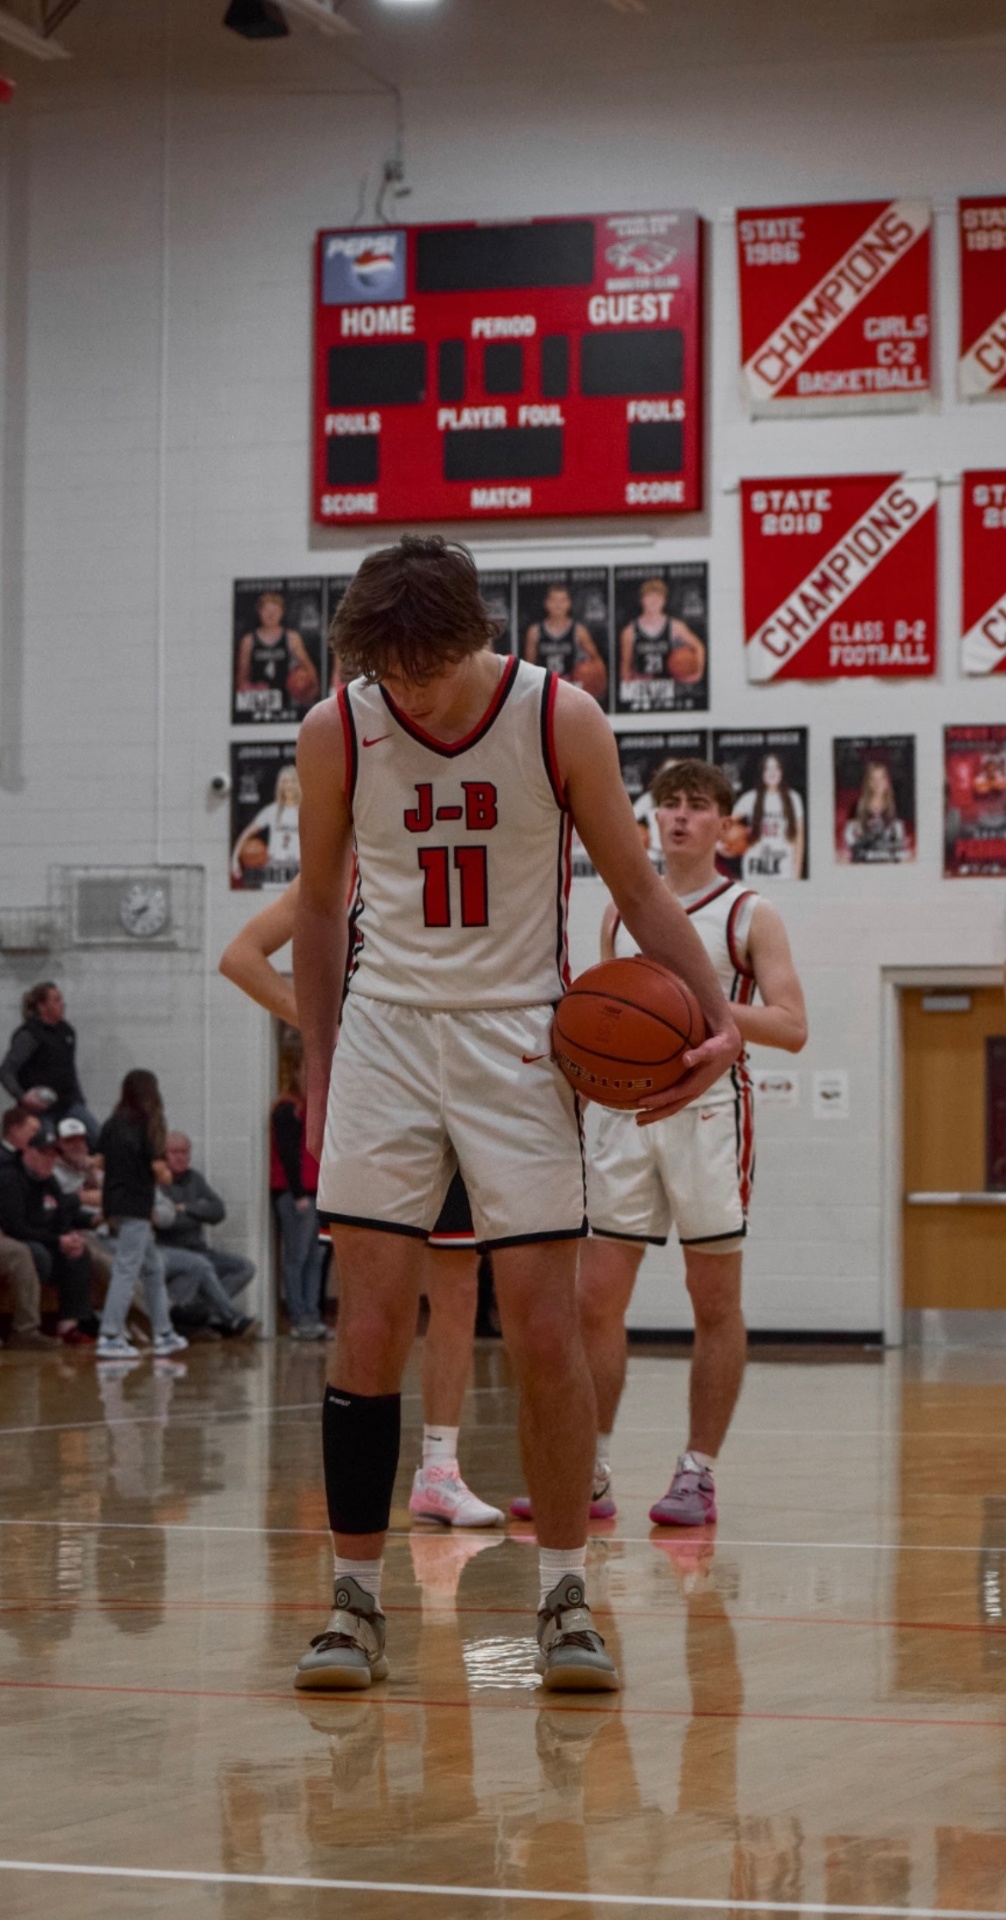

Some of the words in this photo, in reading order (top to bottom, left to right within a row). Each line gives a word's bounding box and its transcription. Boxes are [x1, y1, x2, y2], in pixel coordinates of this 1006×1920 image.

[741, 217, 804, 241] STATE
[326, 235, 399, 258] PEPSI
[589, 293, 675, 326] GUEST
[753, 211, 914, 385] CHAMPIONS
[341, 305, 416, 337] HOME
[472, 315, 537, 339] PERIOD
[863, 315, 929, 341] GIRLS
[877, 341, 917, 365] C-2
[797, 365, 927, 393] BASKETBALL
[438, 406, 507, 430] PLAYER
[519, 404, 565, 427] FOUL
[627, 399, 685, 423] FOULS
[325, 412, 381, 435] FOULS
[321, 492, 379, 515] SCORE
[471, 487, 532, 509] MATCH
[626, 481, 684, 505] SCORE
[750, 488, 832, 512] STATE
[760, 489, 919, 658] CHAMPIONS
[829, 621, 884, 642] CLASS
[829, 644, 931, 667] FOOTBALL
[403, 781, 499, 833] J-B
[748, 857, 782, 876] FALK
[417, 845, 489, 928] 11
